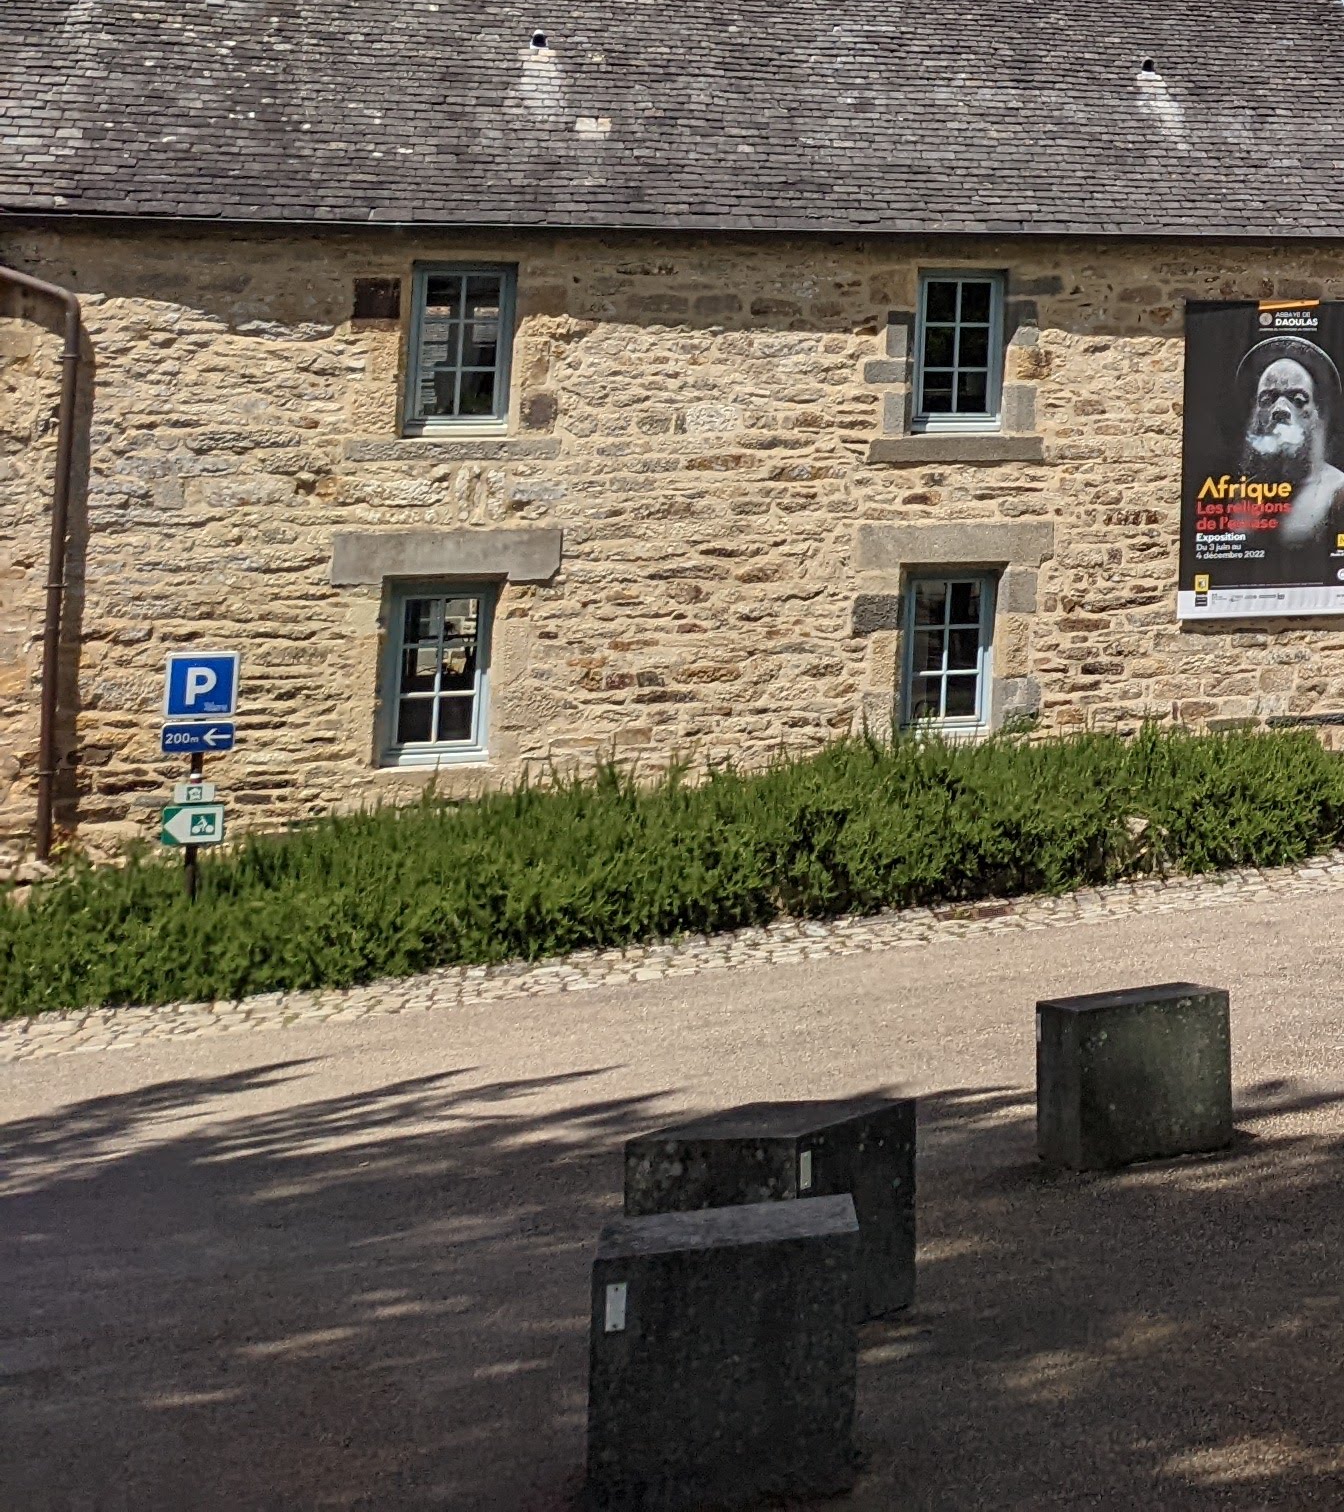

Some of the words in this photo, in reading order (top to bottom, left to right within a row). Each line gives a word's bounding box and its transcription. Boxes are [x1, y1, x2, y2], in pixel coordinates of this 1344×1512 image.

[1275, 318, 1319, 326] DAOULAS
[1197, 475, 1292, 505] Afrique
[1197, 501, 1224, 514] Les
[1227, 499, 1292, 516] religions
[1196, 516, 1217, 530] de
[1196, 532, 1246, 543] Exposition
[1216, 543, 1231, 552] juin
[1203, 551, 1243, 559] décembre
[1244, 550, 1265, 558] 2022
[185, 666, 217, 705] P
[164, 732, 199, 745] 200m
